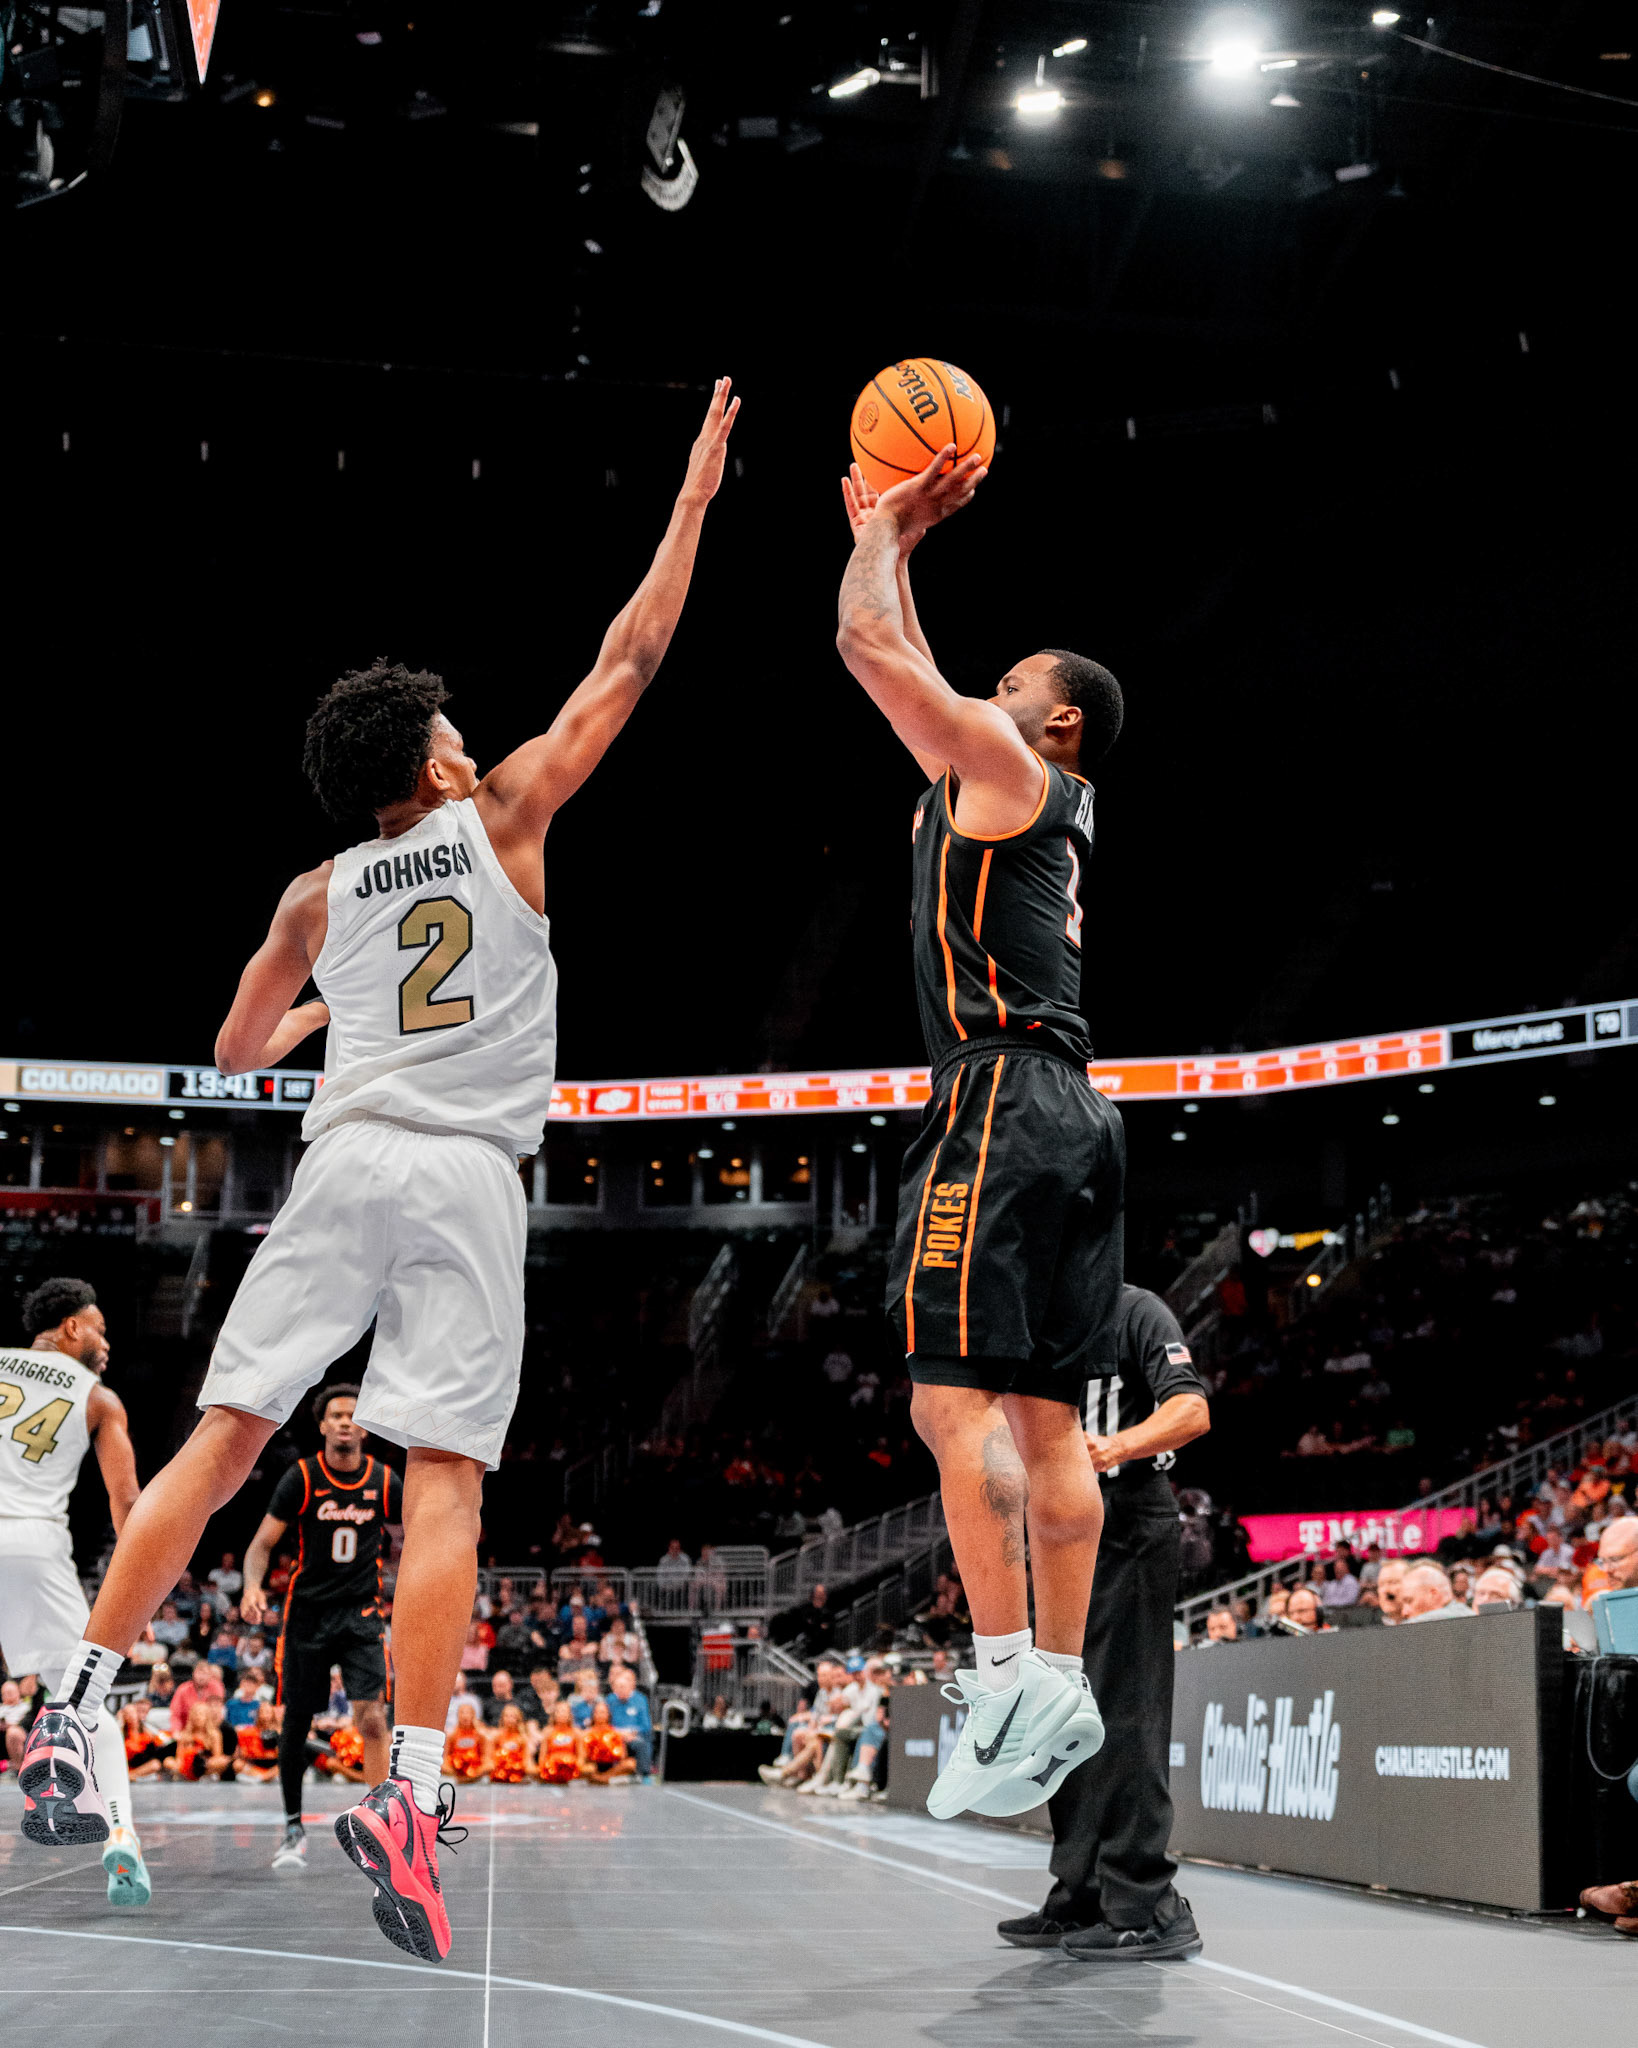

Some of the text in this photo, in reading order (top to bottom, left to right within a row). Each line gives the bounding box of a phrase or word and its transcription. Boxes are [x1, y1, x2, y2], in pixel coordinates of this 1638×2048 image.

[895, 362, 939, 424] Wilso
[398, 895, 475, 1036] 2
[21, 1068, 160, 1096] COLORADO
[181, 1070, 260, 1099] 13:41
[922, 1183, 969, 1269] POKES
[332, 1527, 358, 1563] 0
[1327, 1517, 1422, 1551] Mobie
[1201, 1690, 1341, 1822] Charlie Hustle
[1375, 1746, 1510, 1780] CHARLIEHUSTLE.COM
